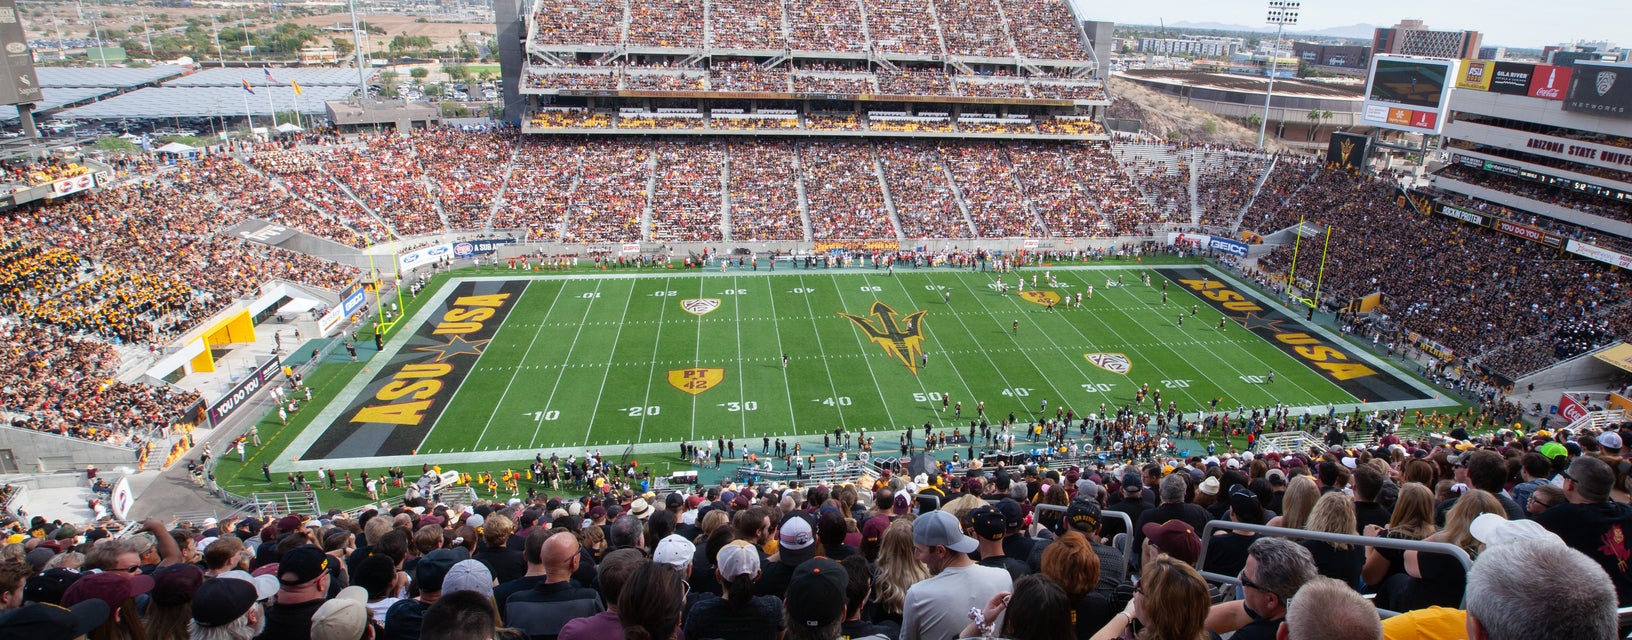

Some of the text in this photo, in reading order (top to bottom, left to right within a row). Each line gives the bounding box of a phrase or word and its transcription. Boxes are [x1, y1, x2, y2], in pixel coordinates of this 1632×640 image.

[1510, 72, 1528, 80] RIVER
[1572, 101, 1624, 113] NETWORKS
[1527, 138, 1632, 166] ARIZONA STATE UNIVE
[1441, 205, 1483, 225] ROCKIN PROTEIN
[1501, 221, 1540, 240] YOU DO YOU
[1211, 240, 1248, 256] GEICO
[725, 288, 748, 296] 30
[1178, 279, 1380, 381] ASU USA
[348, 293, 509, 426] ASU USA
[683, 370, 709, 379] PT
[1239, 374, 1263, 385] 10
[683, 380, 709, 390] 42
[1081, 382, 1111, 393] 30
[1161, 379, 1190, 389] 20
[217, 377, 259, 417] YOU DO YOU
[913, 391, 942, 402] 50
[1001, 387, 1030, 398] 40
[735, 400, 768, 412] 30
[823, 396, 852, 407] 40
[534, 410, 560, 421] 10
[628, 405, 660, 417] 20
